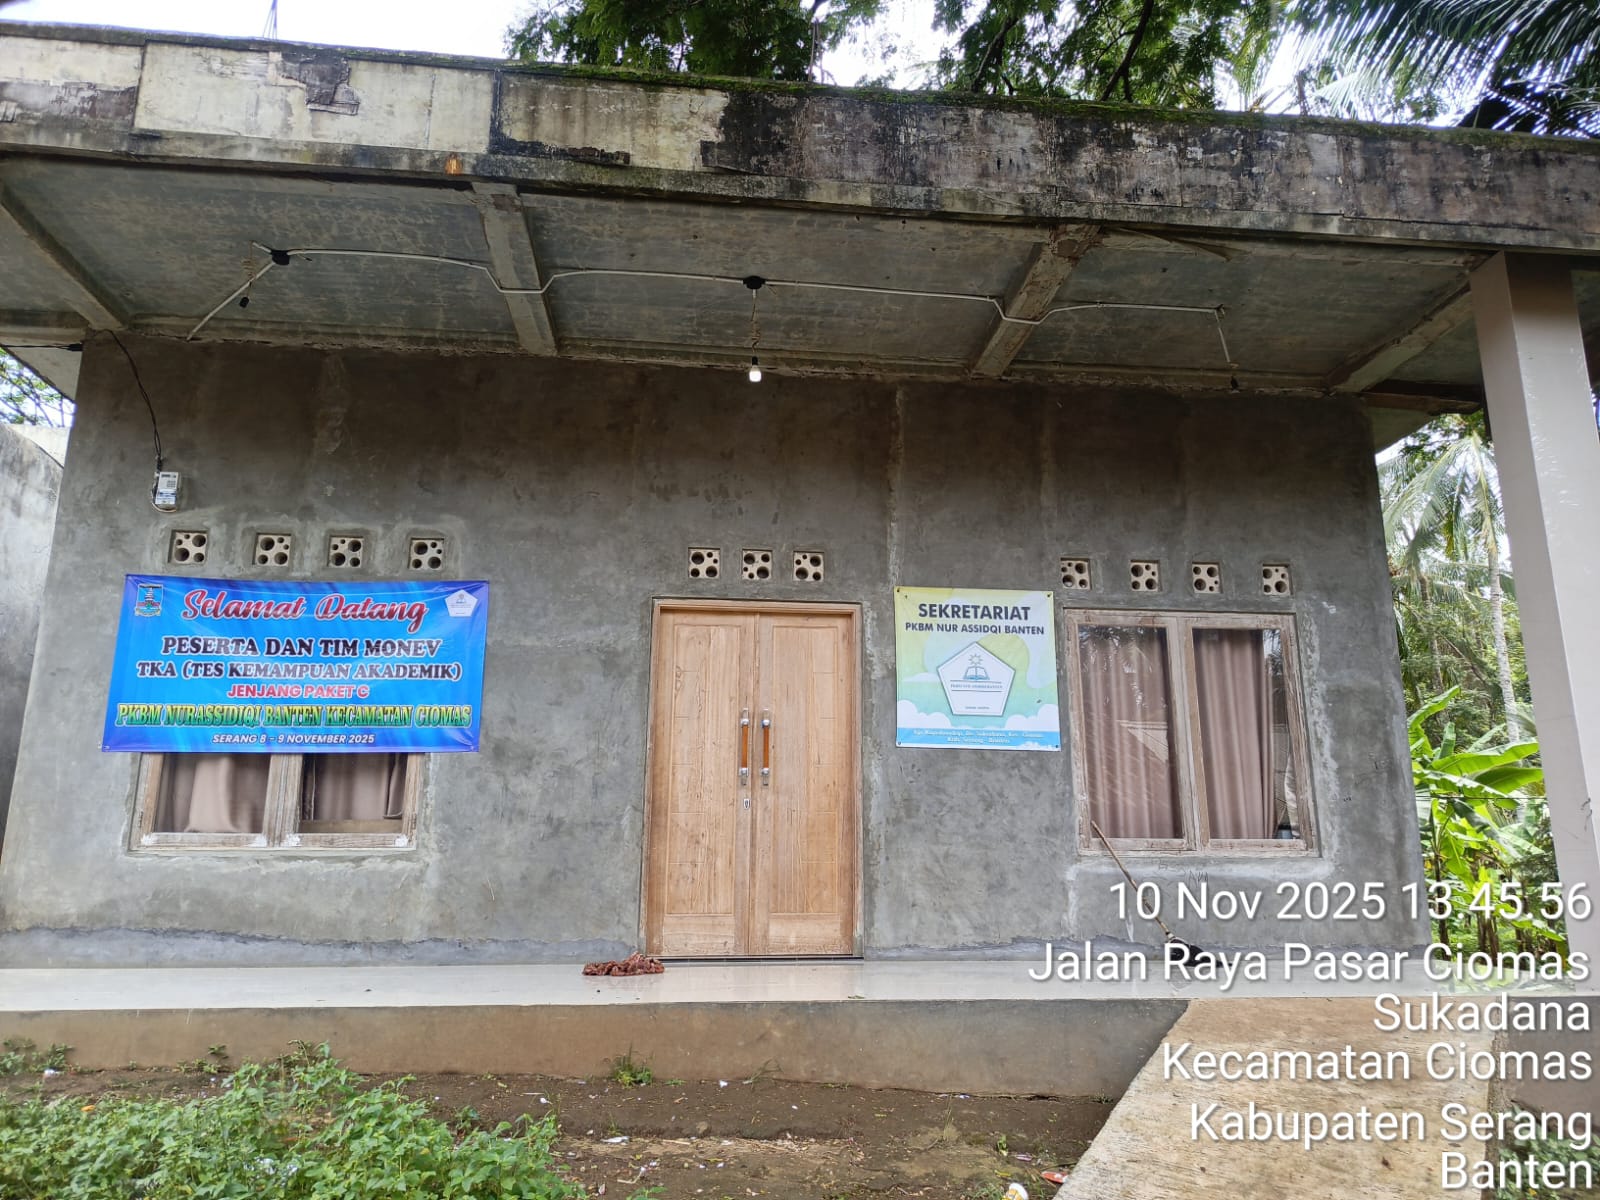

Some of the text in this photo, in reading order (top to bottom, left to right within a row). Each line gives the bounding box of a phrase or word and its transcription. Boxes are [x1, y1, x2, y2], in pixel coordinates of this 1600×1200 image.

[182, 589, 428, 633] Selamat Datang
[918, 604, 1031, 620] SEKRETARIAT
[905, 622, 1045, 635] PKBM NUR ASSIDQI BANTEN
[162, 636, 442, 656] PESERTA DAN TIM MONEV
[137, 661, 462, 680] TKA (TES KEMAMPUAN AKADEMIK)
[227, 684, 369, 698] JENJANG PAKET C
[116, 704, 163, 727] PKBM
[263, 705, 322, 728] BANTEN
[325, 705, 413, 728] KECAMATAN
[415, 706, 472, 728] CIOMAS
[213, 734, 257, 743] SERANG
[259, 734, 266, 743] 8
[278, 735, 284, 743] 9
[286, 735, 346, 744] NOVEMBER
[349, 735, 375, 744] 2025
